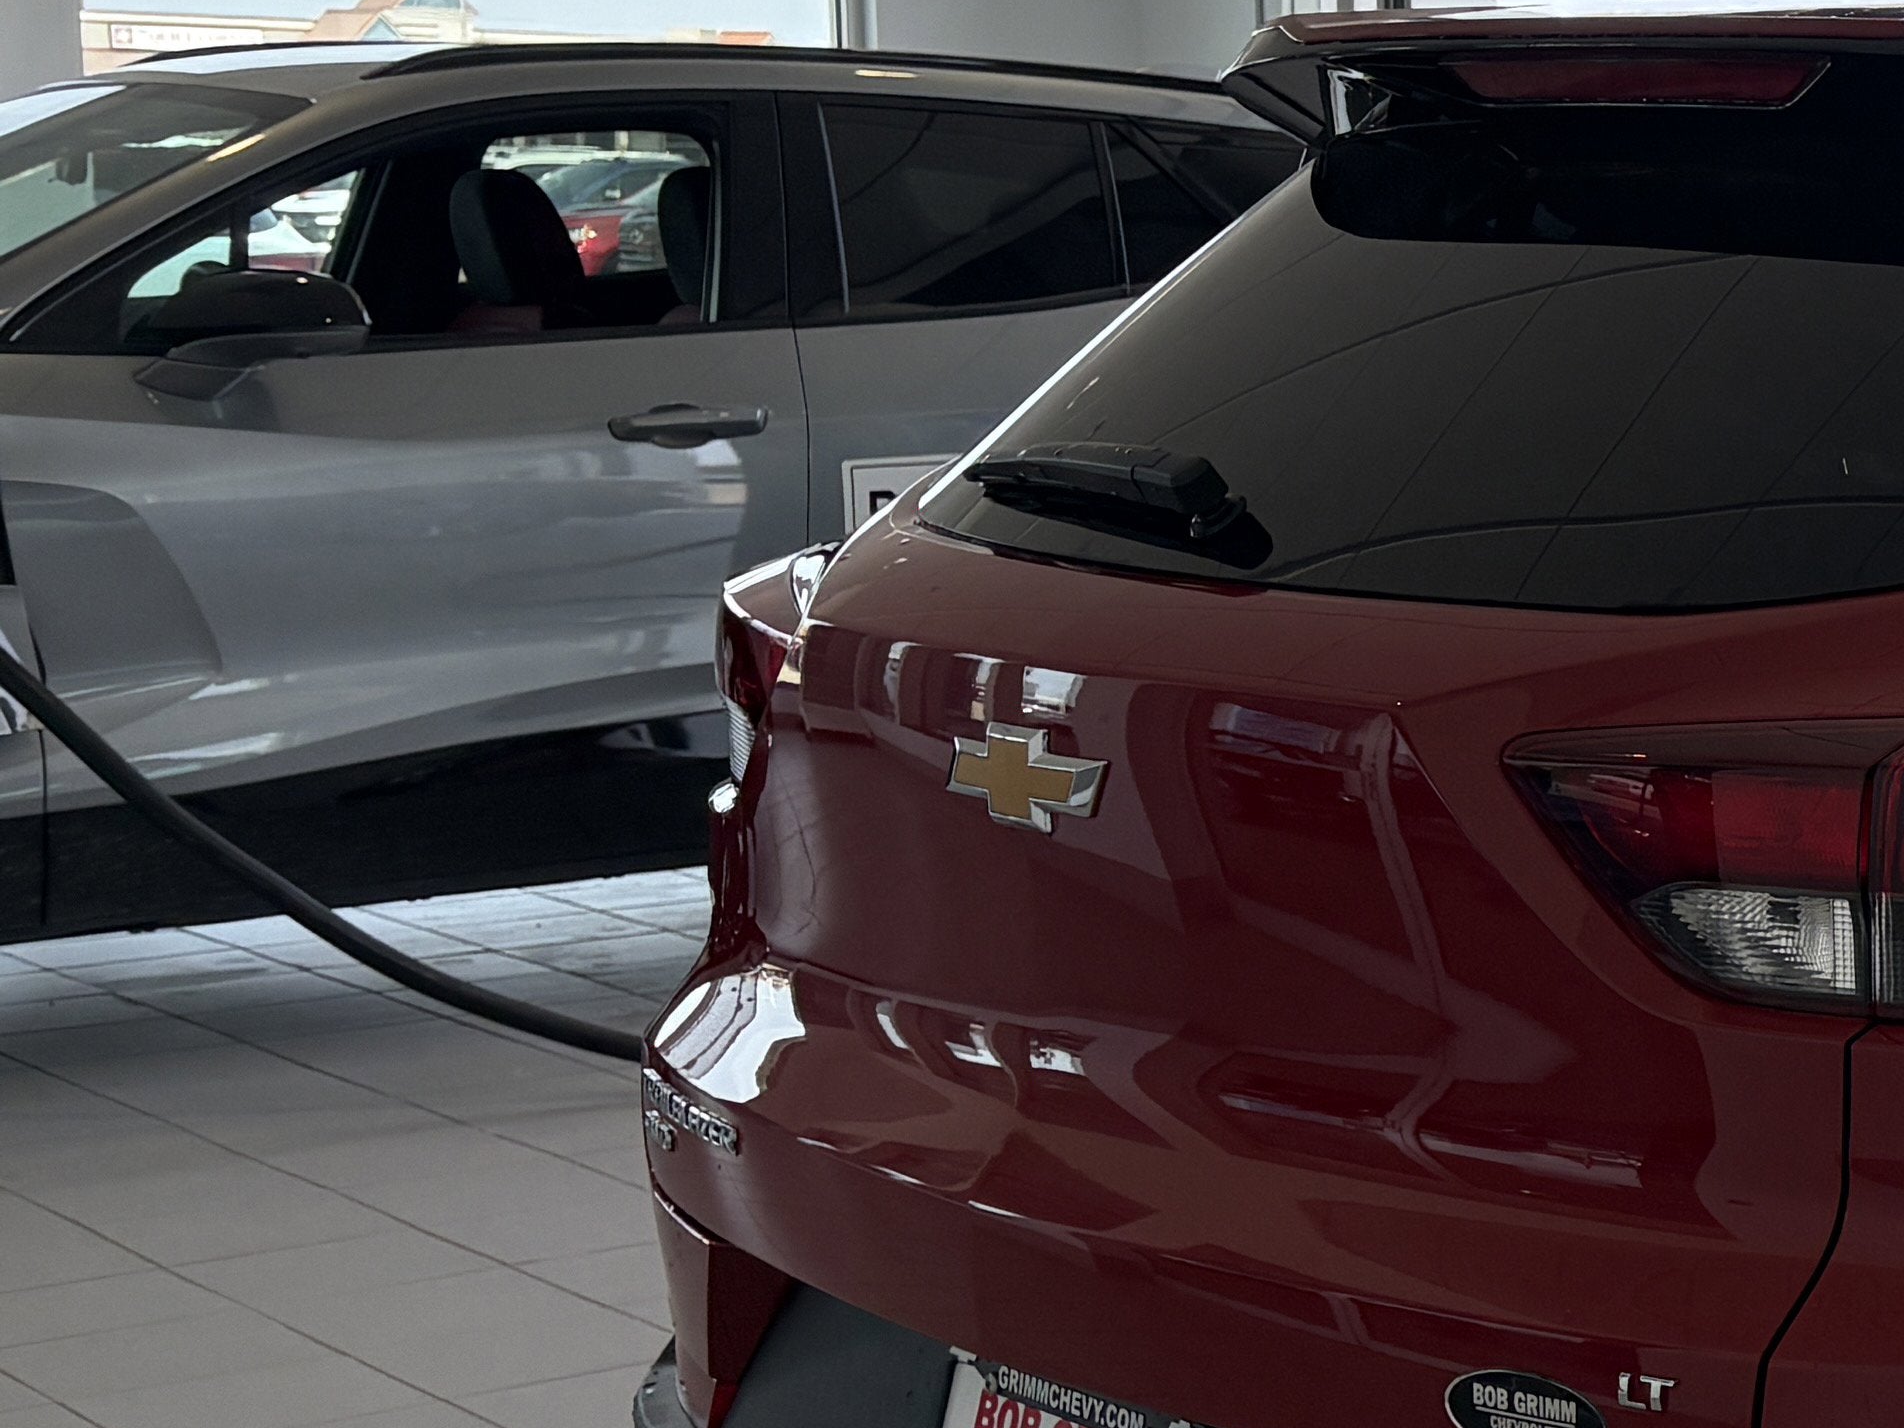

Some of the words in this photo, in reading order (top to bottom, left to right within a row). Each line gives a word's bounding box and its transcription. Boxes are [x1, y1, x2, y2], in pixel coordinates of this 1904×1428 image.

[1473, 1382, 1509, 1410] BOB
[1513, 1391, 1577, 1424] GRIMM
[1617, 1372, 1675, 1412] LT
